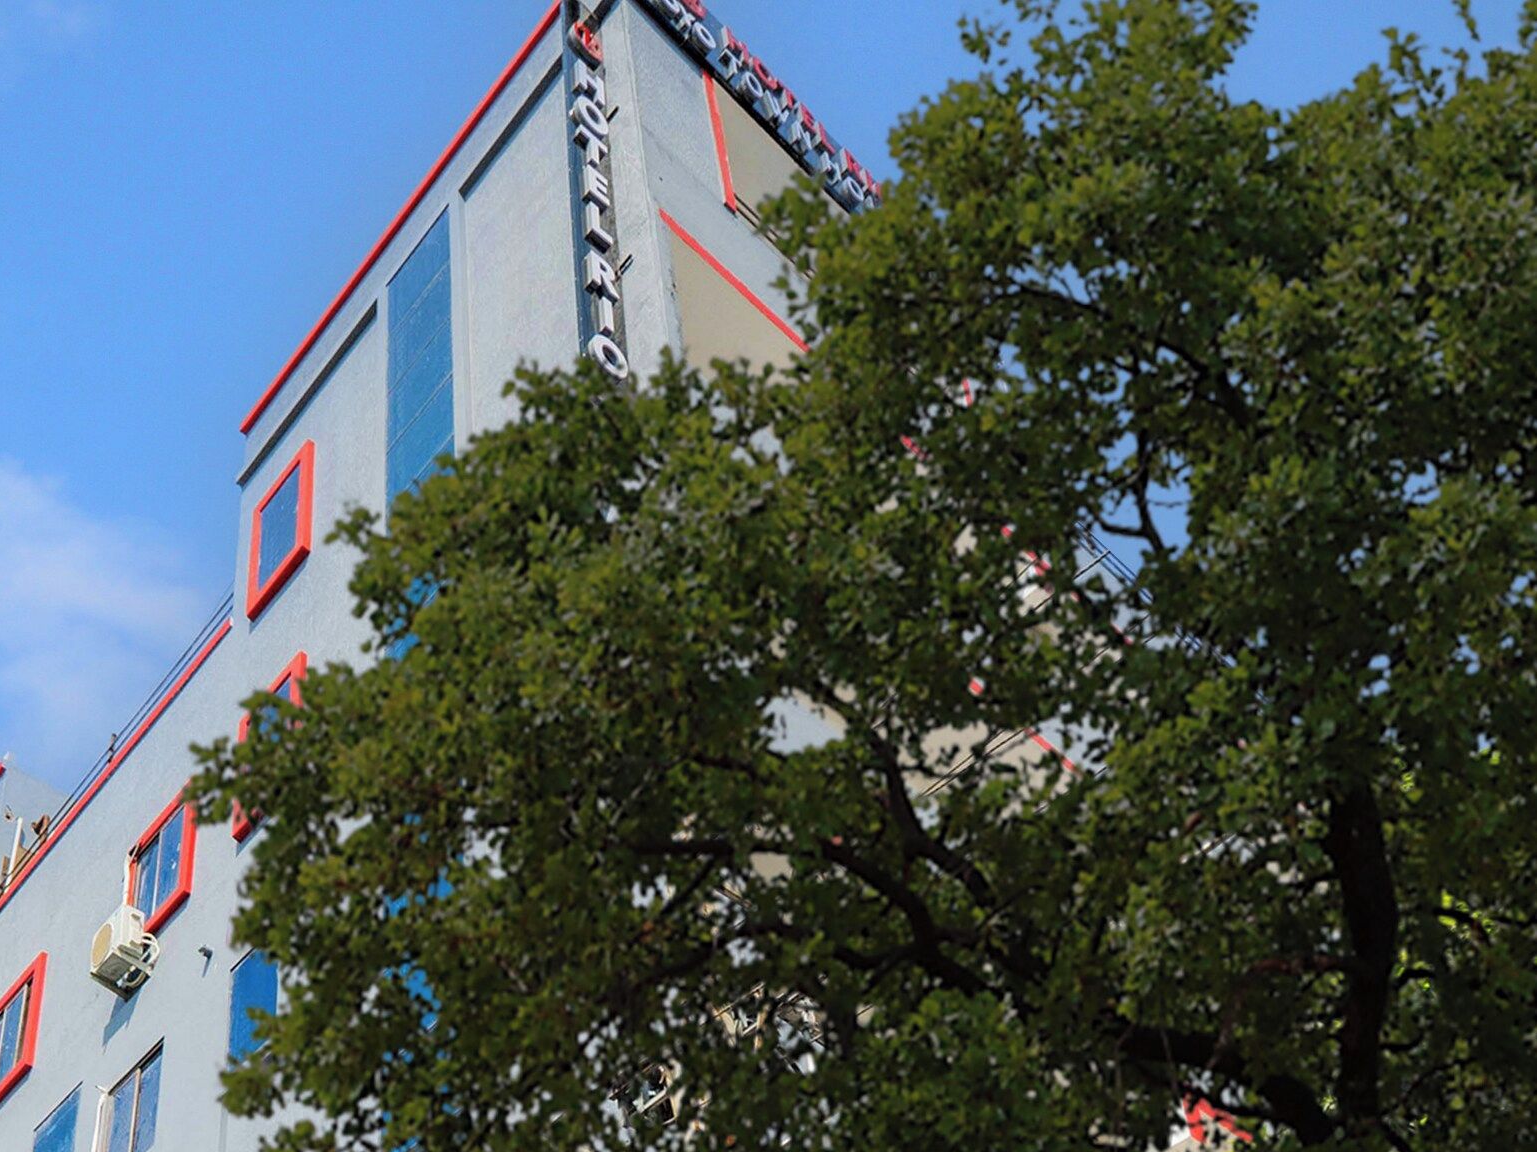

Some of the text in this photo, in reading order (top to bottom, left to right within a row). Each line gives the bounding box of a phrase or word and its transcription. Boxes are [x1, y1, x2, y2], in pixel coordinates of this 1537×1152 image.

[572, 59, 630, 382] HOTEL RIO
[720, 24, 882, 203] HOTEL RI
